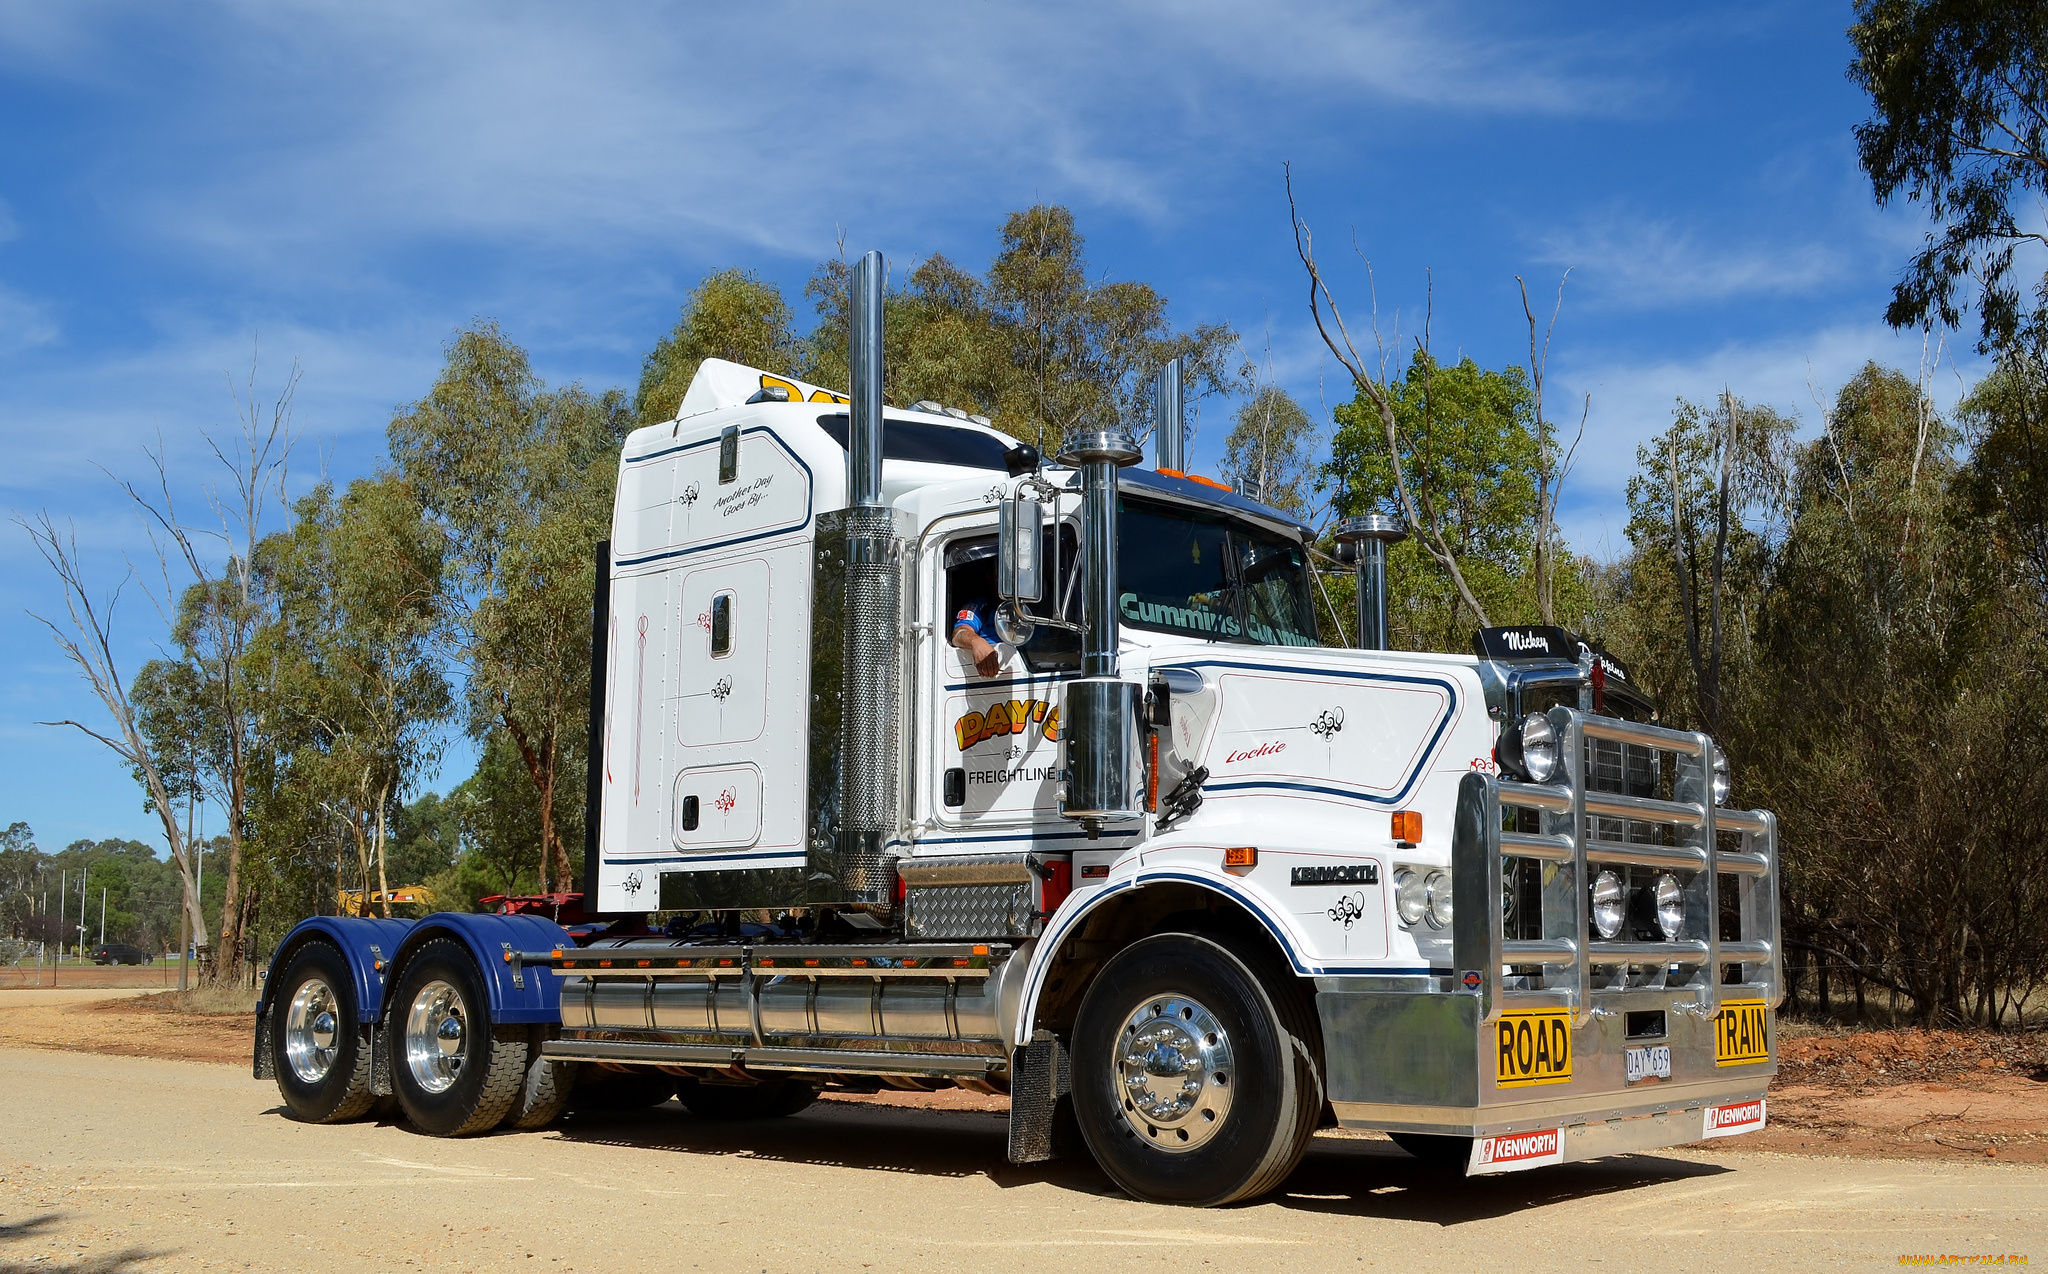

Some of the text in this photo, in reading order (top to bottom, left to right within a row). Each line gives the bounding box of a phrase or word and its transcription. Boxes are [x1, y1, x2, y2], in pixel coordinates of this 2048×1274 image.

[713, 474, 774, 510] Another Day
[723, 501, 746, 517] Goes
[1502, 630, 1549, 653] Mickey
[1577, 641, 1626, 680] Pppins
[968, 766, 1056, 785] FREIGHTLINE
[1291, 865, 1378, 885] KENWORTH
[1714, 1008, 1768, 1057] TRAIN
[1499, 1018, 1568, 1076] ROAD
[1628, 1048, 1669, 1074] DAY 659
[1718, 1103, 1760, 1125] KENWORTH
[1495, 1133, 1556, 1159] KENWORTH
